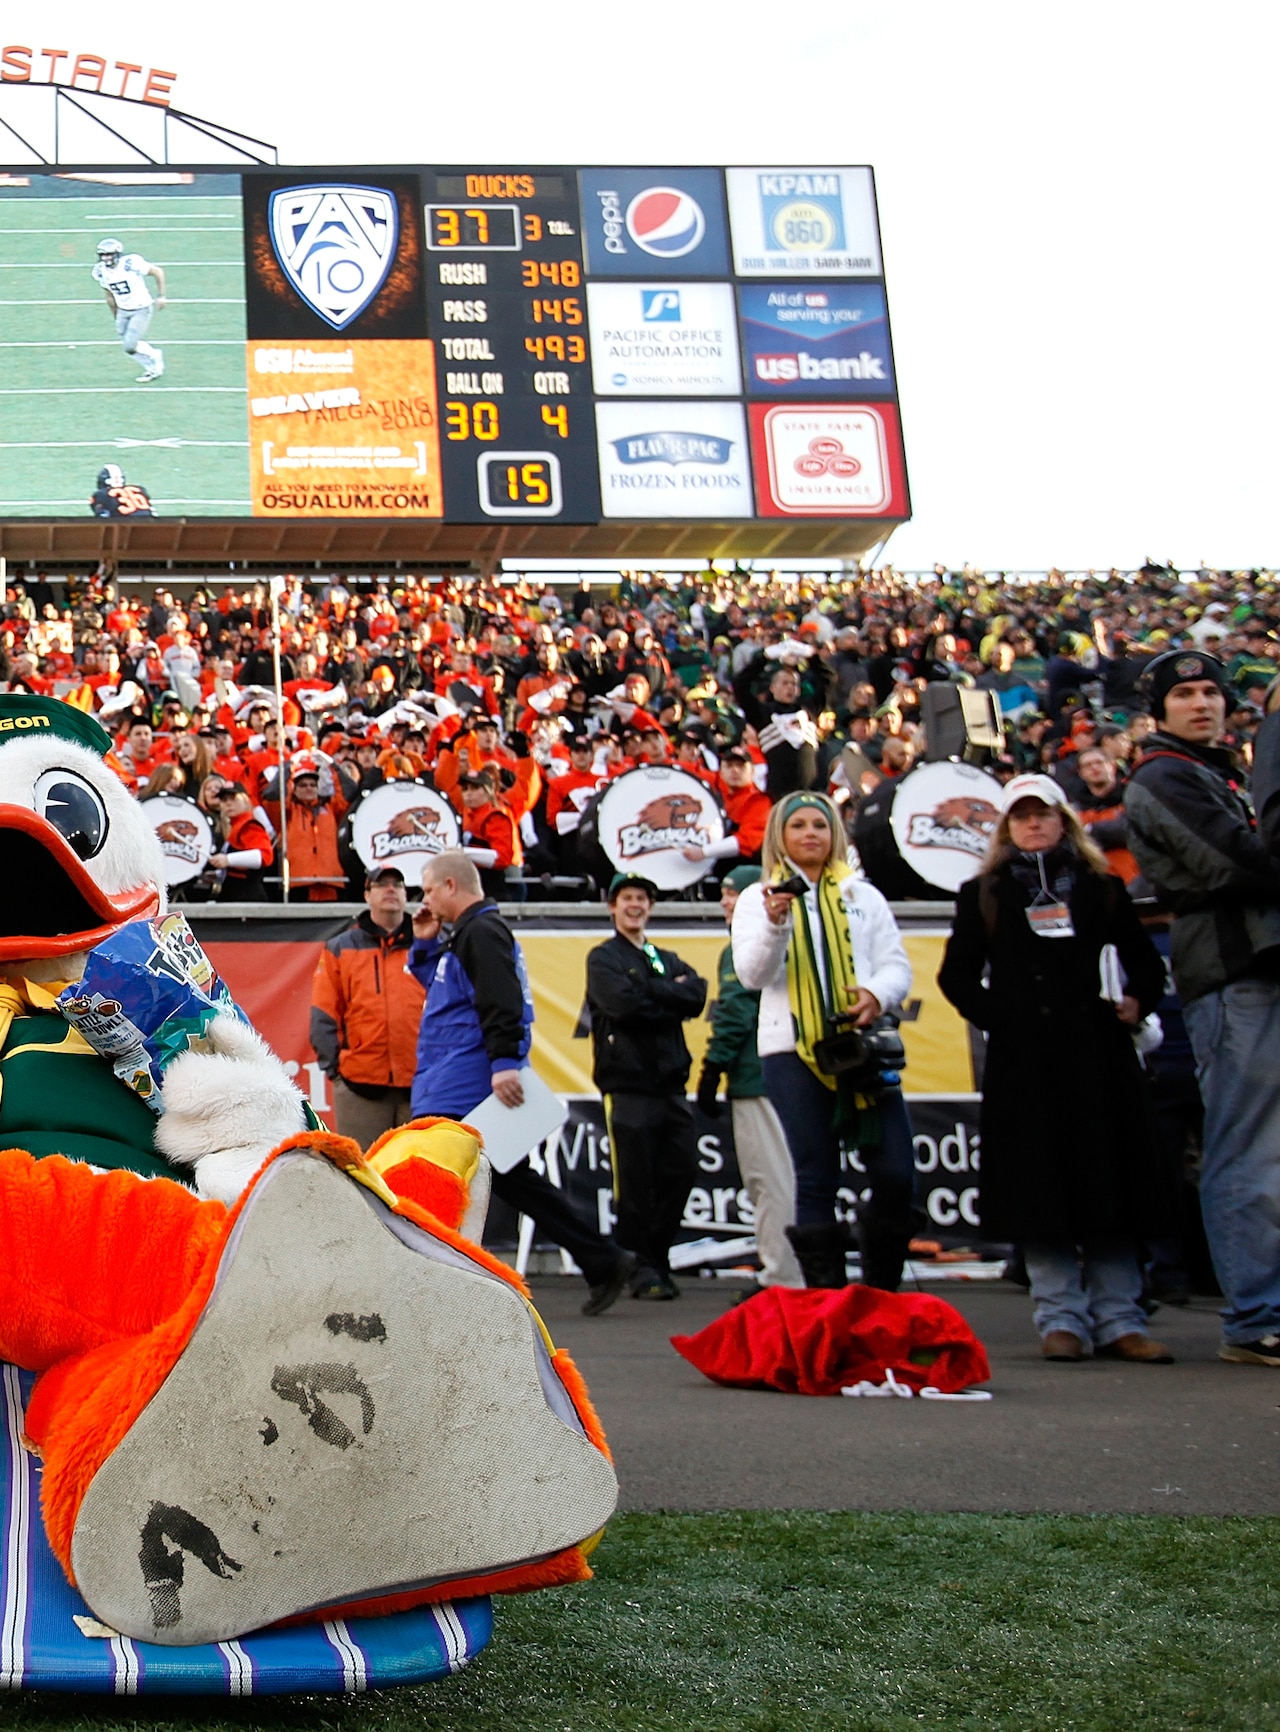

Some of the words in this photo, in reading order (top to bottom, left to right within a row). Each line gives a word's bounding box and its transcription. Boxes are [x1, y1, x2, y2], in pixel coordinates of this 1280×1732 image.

[1, 46, 177, 106] STATE
[465, 175, 535, 198] DUCKS
[761, 176, 839, 196] KPAM
[435, 209, 489, 247] 37
[524, 214, 542, 241] 3
[596, 190, 628, 254] pepsi
[785, 220, 825, 243] 860
[439, 263, 487, 284] RUSH
[522, 260, 580, 287] 348
[443, 301, 487, 323] PASS
[532, 298, 582, 325] 145
[805, 295, 827, 307] us
[777, 309, 829, 324] serving
[603, 330, 662, 342] PACIFIC
[669, 330, 723, 342] OFFICE
[441, 338, 495, 360] TOTAL
[524, 336, 586, 363] 493
[609, 346, 722, 357] AUTOMATION
[446, 372, 480, 394] BALL
[481, 372, 503, 394] ON
[534, 372, 569, 394] QTR
[381, 410, 434, 431] 2010
[445, 402, 499, 440] 30
[541, 404, 568, 438] 4
[506, 464, 549, 503] 15
[610, 474, 676, 489] FROZEN
[682, 474, 741, 489] FOODS
[108, 486, 150, 515] 36
[263, 494, 429, 509] OSUALUM.COM
[75, 1013, 101, 1029] ATTLE
